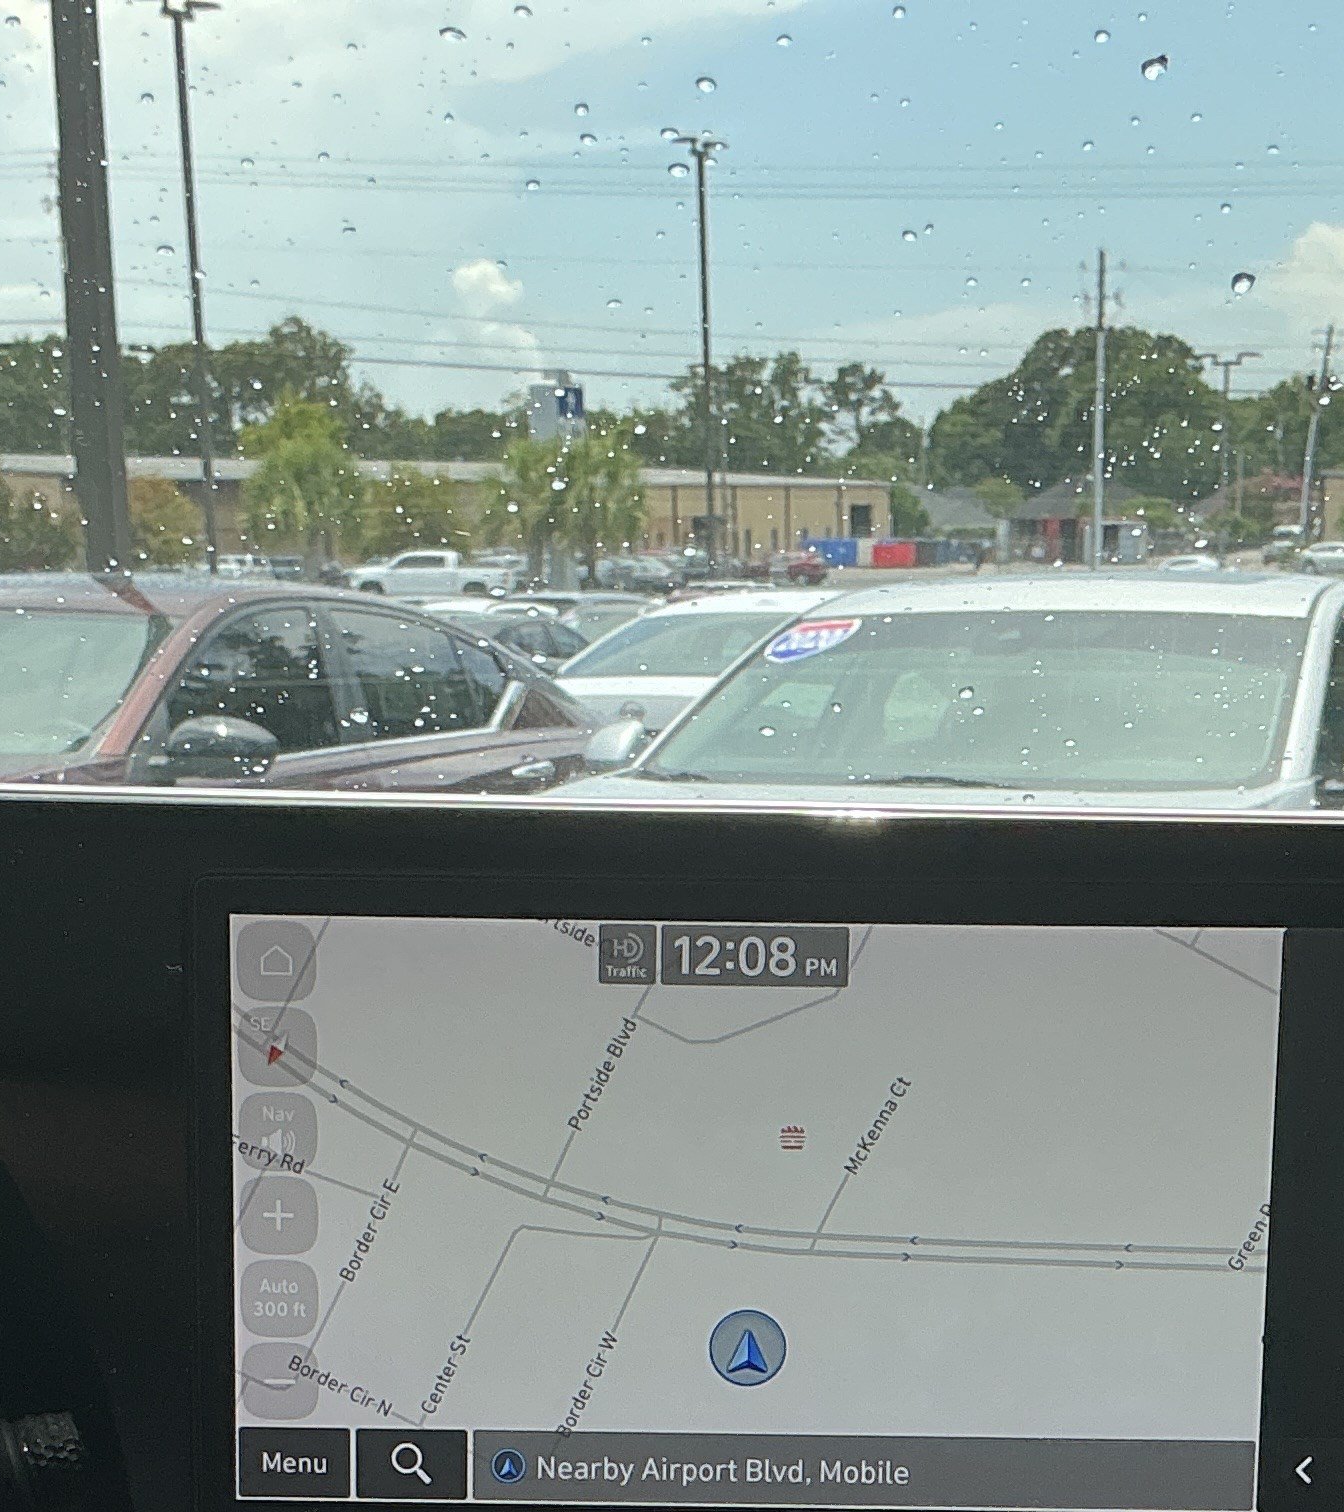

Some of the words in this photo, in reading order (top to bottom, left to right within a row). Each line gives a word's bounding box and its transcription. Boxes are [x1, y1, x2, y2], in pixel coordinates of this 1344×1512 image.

[607, 965, 647, 978] Traffic
[673, 935, 797, 977] 12:08
[805, 958, 837, 977] PM
[251, 1017, 272, 1031] SE
[567, 1060, 615, 1132] Portside
[606, 1016, 637, 1058] Blvd
[262, 1106, 295, 1123] Nav
[844, 1099, 898, 1175] McKenna
[890, 1076, 912, 1097] Ct
[280, 1153, 306, 1174] Rd
[339, 1222, 378, 1283] Border
[369, 1194, 391, 1220] Cir
[382, 1178, 400, 1194] E
[1227, 1220, 1268, 1271] Green
[259, 1277, 299, 1294] Auto
[253, 1301, 288, 1317] 300
[293, 1301, 306, 1318] ft
[288, 1354, 349, 1394] Border
[350, 1386, 375, 1408] Cir
[376, 1399, 393, 1417] N
[421, 1356, 458, 1414] Center
[450, 1333, 471, 1356] St
[556, 1379, 594, 1439] Border
[586, 1352, 608, 1378] Cir
[598, 1330, 618, 1350] W
[262, 1451, 328, 1475] Menu
[537, 1456, 634, 1486] Nearby
[641, 1457, 738, 1487] Airport
[745, 1459, 812, 1486] Blvd,
[820, 1459, 910, 1486] Mobile
